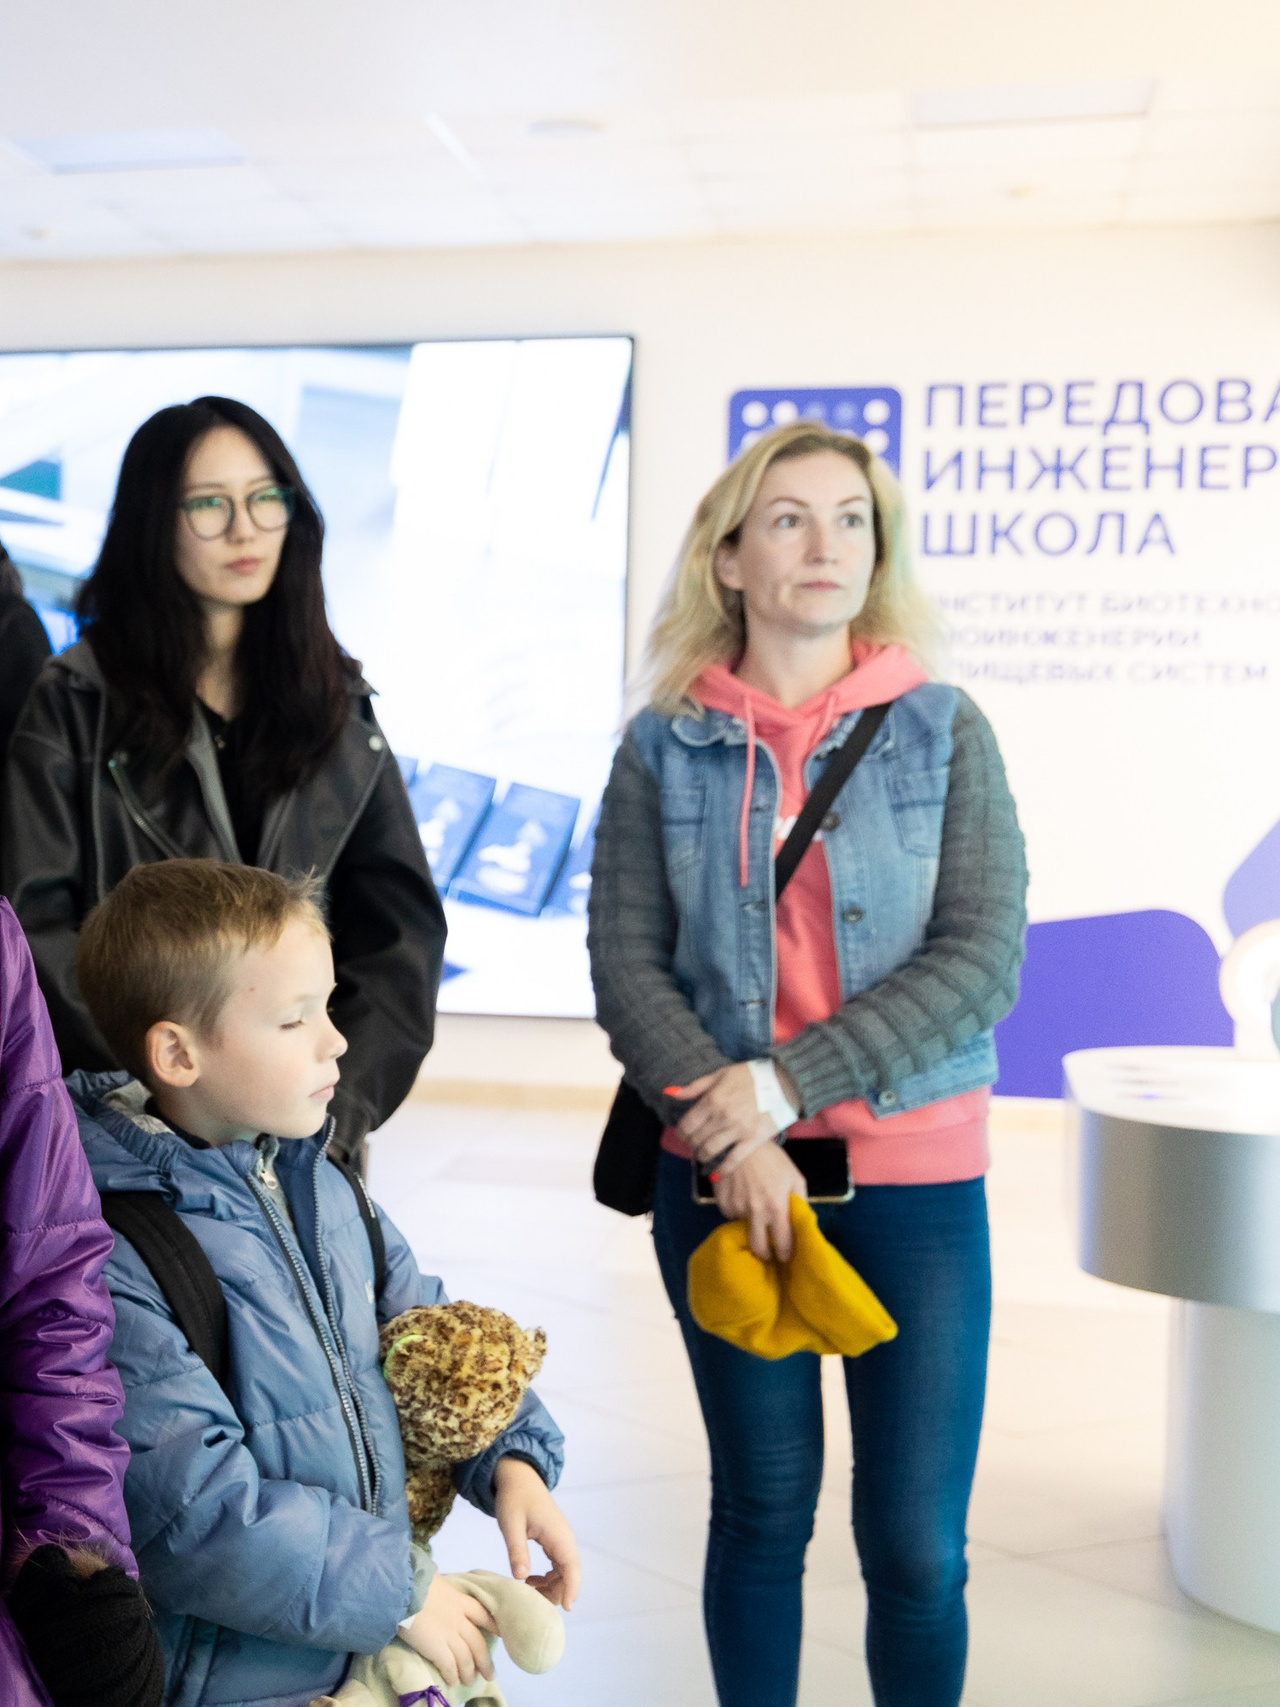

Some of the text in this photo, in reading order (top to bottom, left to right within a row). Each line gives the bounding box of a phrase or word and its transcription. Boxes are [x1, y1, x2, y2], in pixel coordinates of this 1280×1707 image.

[923, 444, 1279, 492] ИНЖЕНЕР
[922, 511, 1176, 557] ШКОЛА
[934, 591, 1089, 614] НСТИТУТ
[948, 626, 1201, 648] ОИНЖЕНЕРИИ
[1126, 661, 1268, 682] СИСТЕМ
